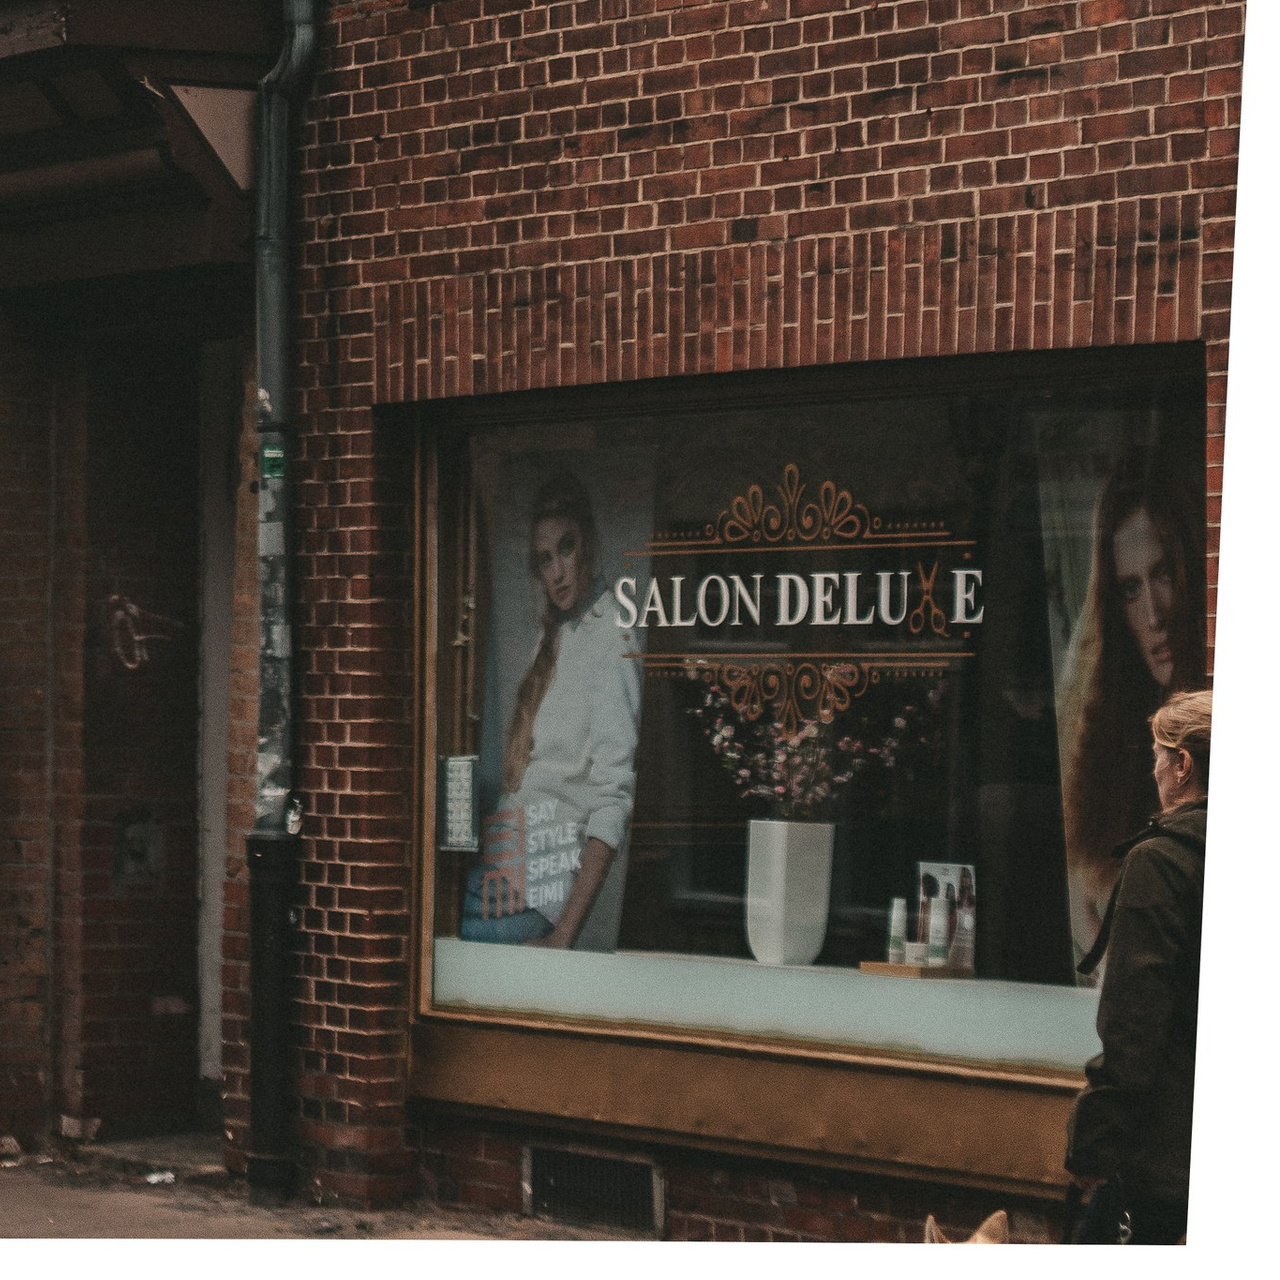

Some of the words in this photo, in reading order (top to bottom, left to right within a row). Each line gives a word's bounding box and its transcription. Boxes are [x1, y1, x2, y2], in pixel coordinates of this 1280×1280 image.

[614, 573, 764, 628] SALON
[525, 800, 559, 826] SAY
[526, 822, 578, 854] STYLE
[526, 848, 582, 881] SPEAK
[526, 881, 564, 907] EIMI
